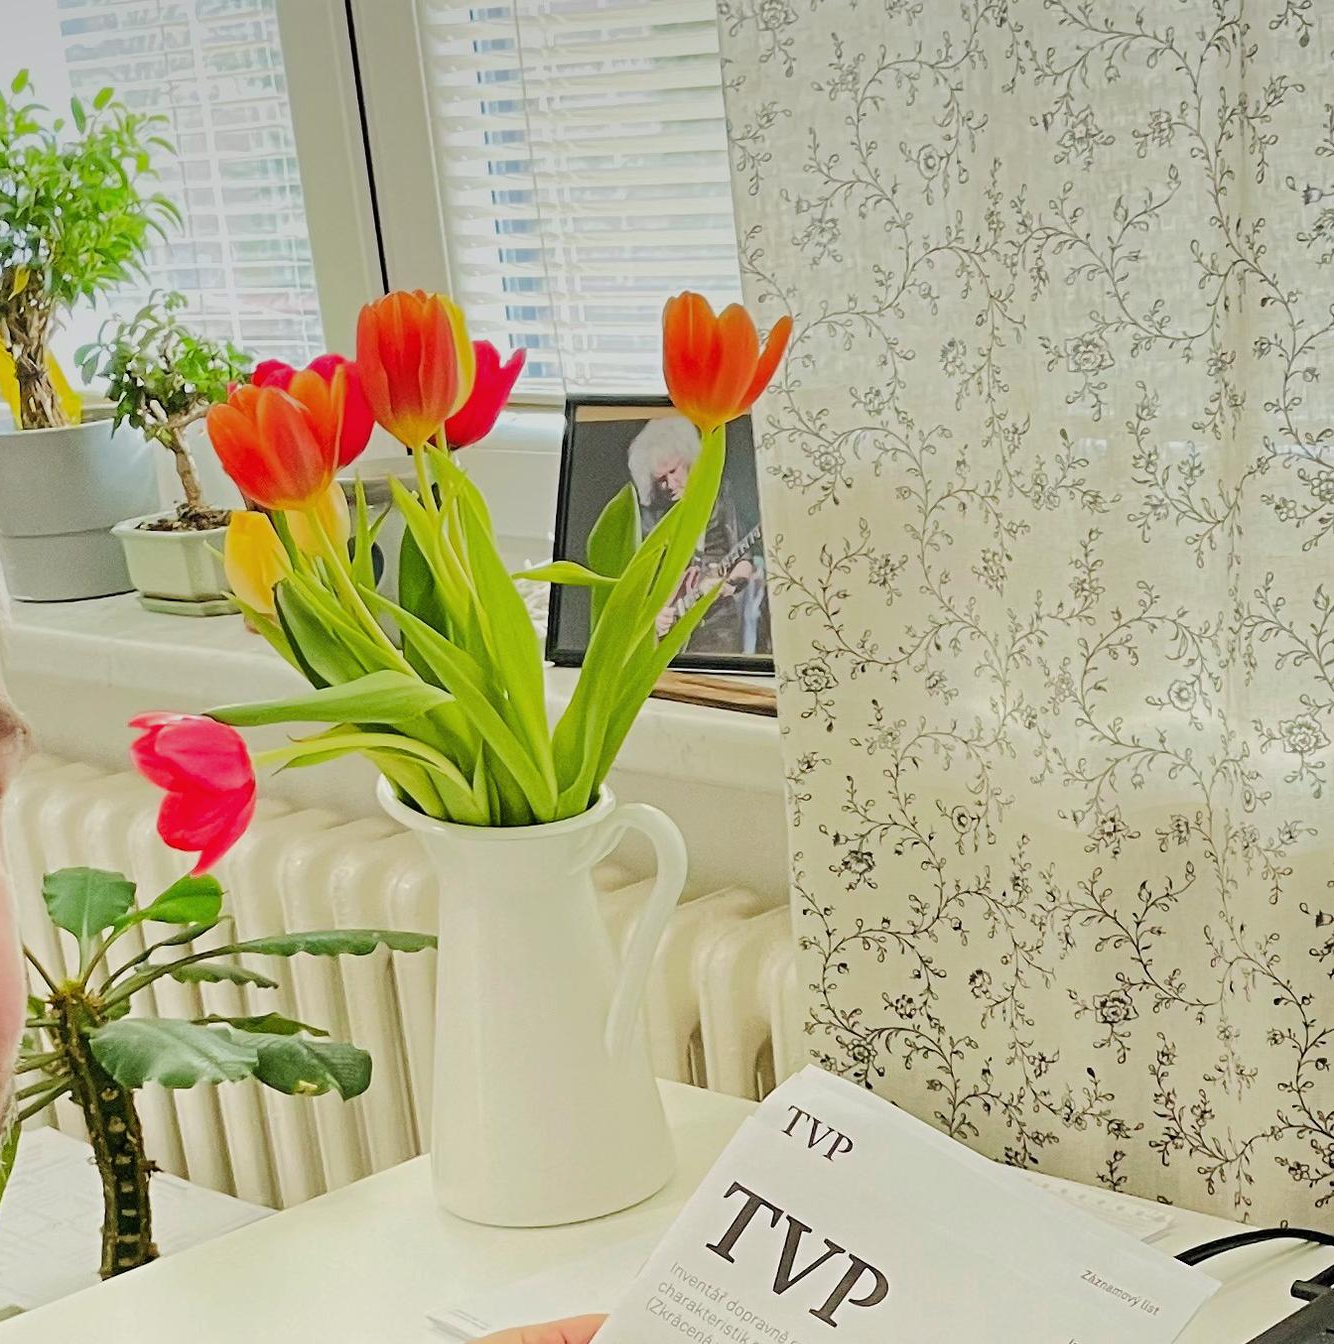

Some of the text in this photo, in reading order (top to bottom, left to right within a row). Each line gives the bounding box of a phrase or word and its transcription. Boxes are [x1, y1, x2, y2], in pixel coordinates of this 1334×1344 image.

[781, 1104, 854, 1161] TVP
[706, 1182, 888, 1327] TVP
[666, 1258, 729, 1308] Inventář
[1079, 1266, 1161, 1317] Záznamový list
